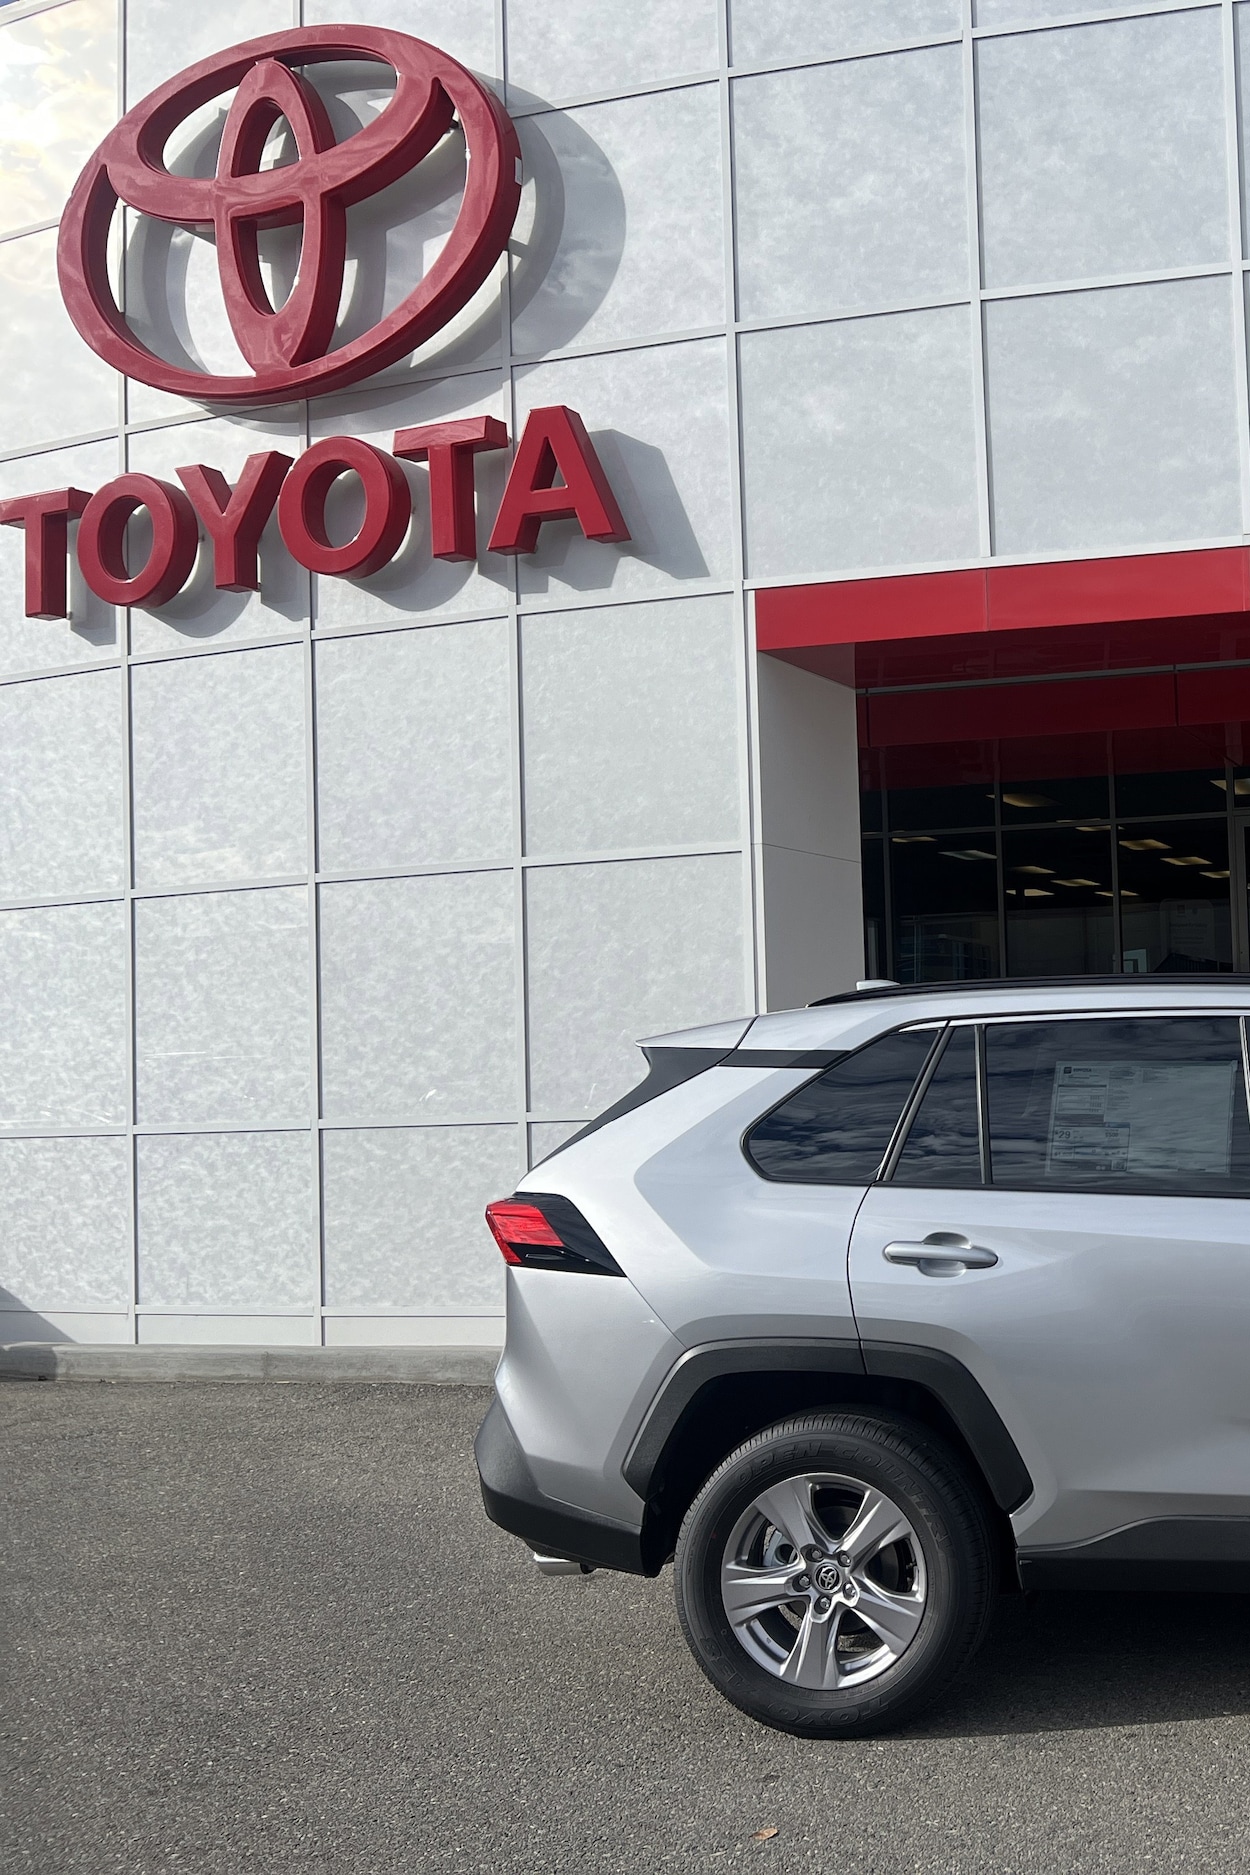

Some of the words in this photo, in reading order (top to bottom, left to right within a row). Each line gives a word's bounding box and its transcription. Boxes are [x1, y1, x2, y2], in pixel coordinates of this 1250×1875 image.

[0, 406, 632, 620] TOYOTA
[734, 1441, 823, 1489] OPEN
[767, 1695, 890, 1727] TOYO
